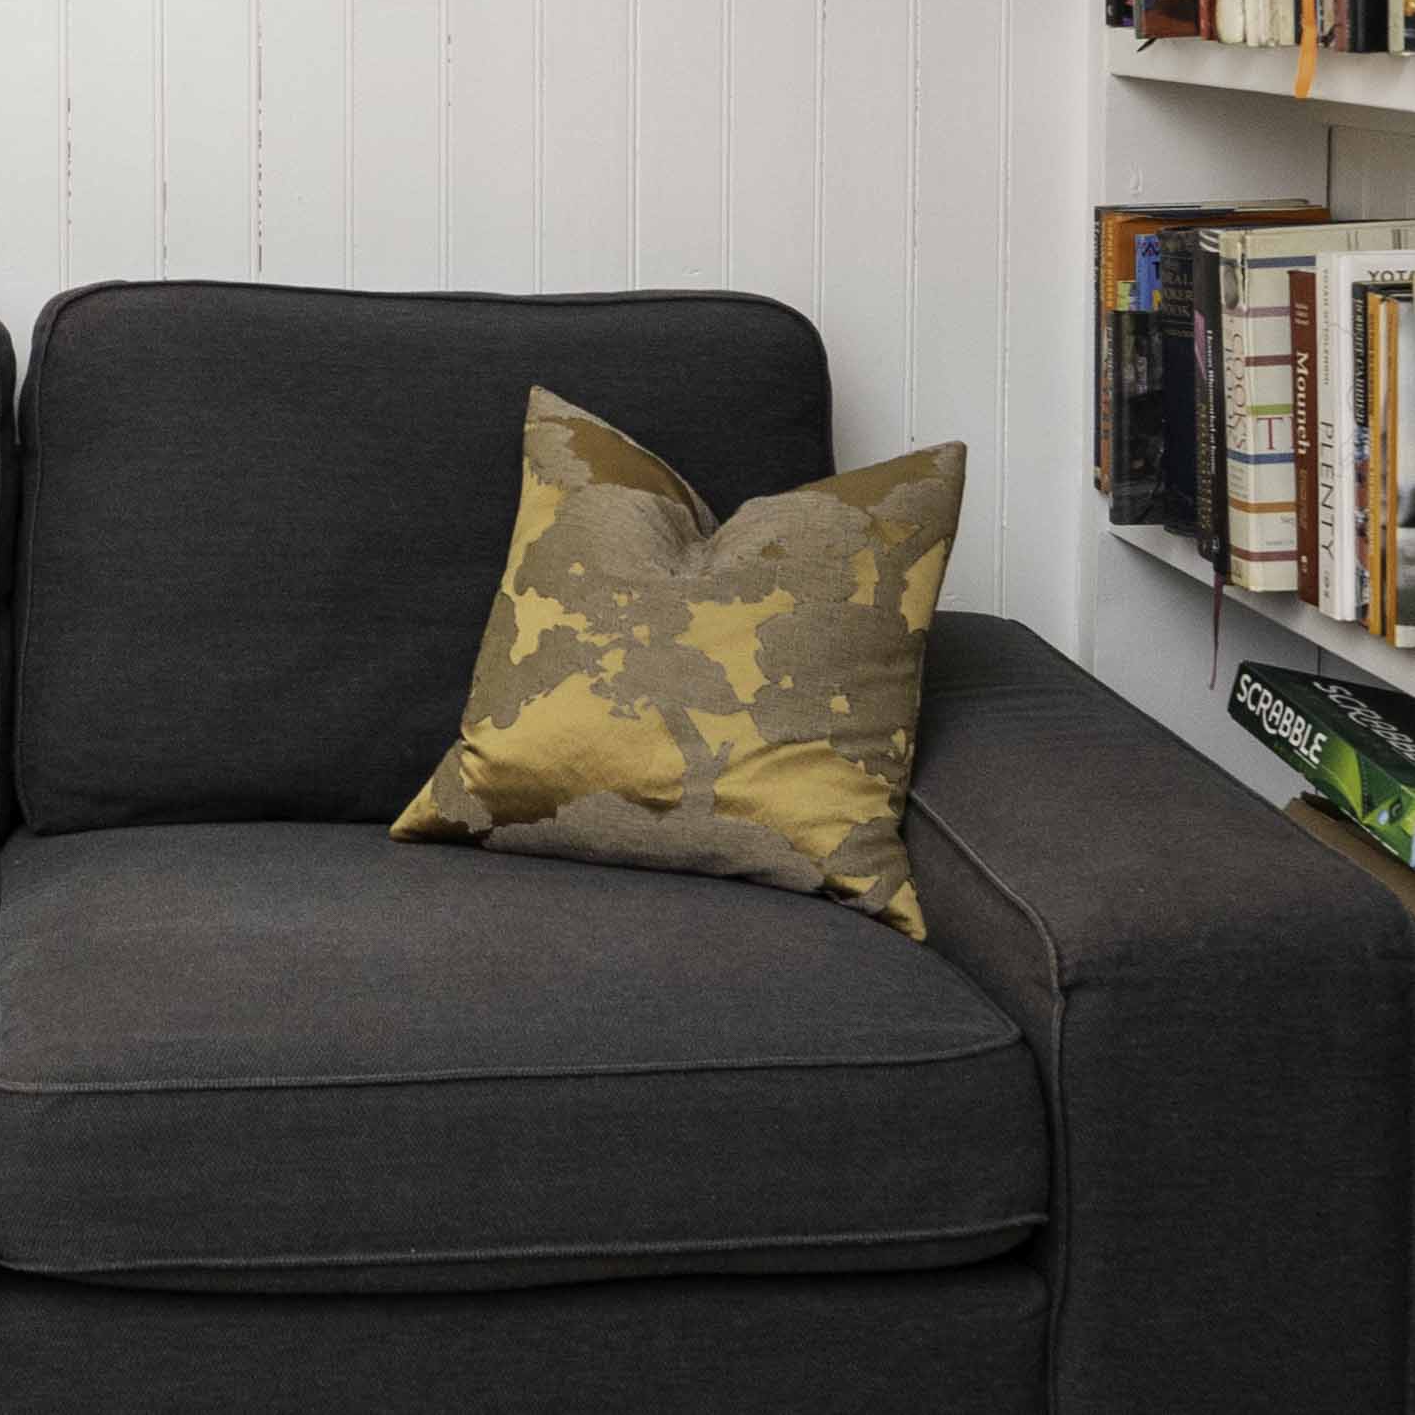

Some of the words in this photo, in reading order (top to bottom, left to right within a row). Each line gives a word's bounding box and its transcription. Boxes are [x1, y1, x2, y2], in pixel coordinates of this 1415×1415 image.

[1367, 270, 1414, 283] YOT
[1297, 352, 1310, 456] Mouneh
[1320, 422, 1335, 561] PLENTY
[1236, 673, 1327, 765] SCRABBLE
